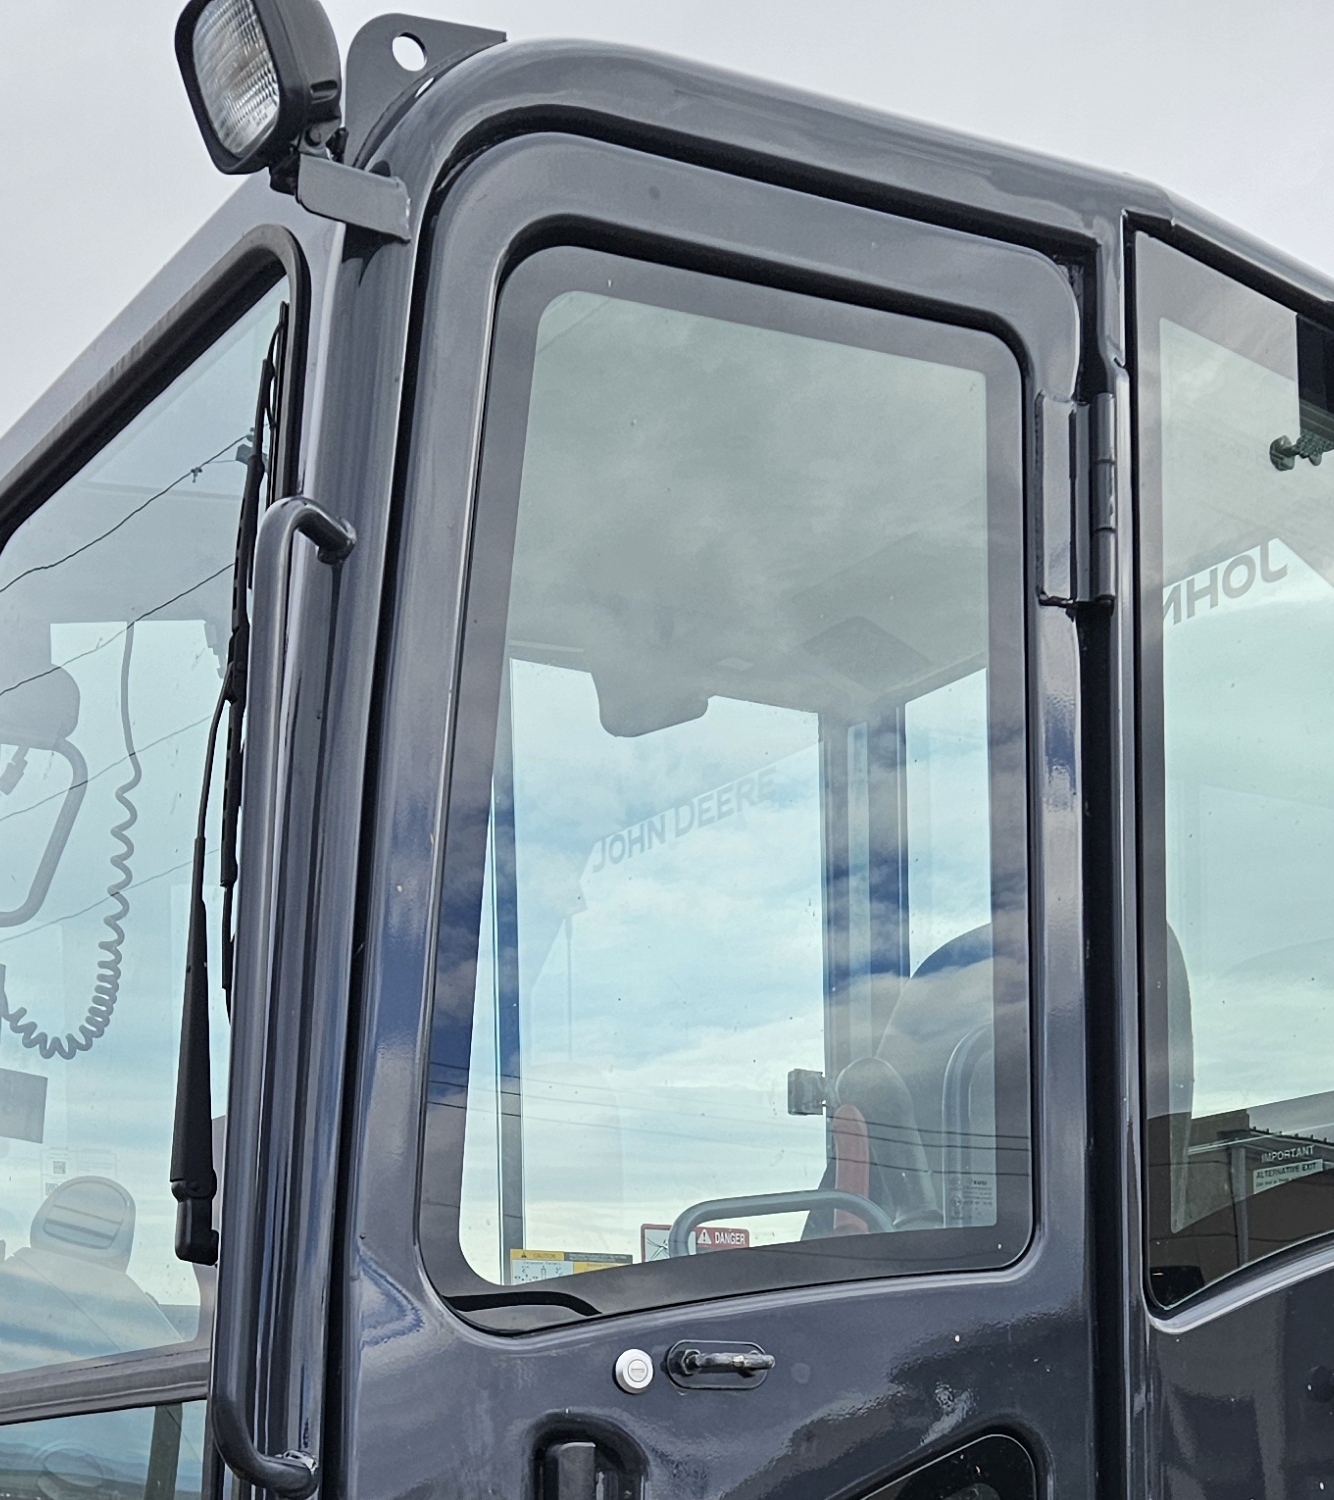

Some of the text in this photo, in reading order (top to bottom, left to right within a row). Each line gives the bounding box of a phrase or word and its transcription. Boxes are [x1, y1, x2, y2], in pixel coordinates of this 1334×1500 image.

[592, 766, 777, 873] JOHN DEERE
[1261, 1145, 1315, 1163] IMPORTANT
[714, 1231, 747, 1246] DANGER
